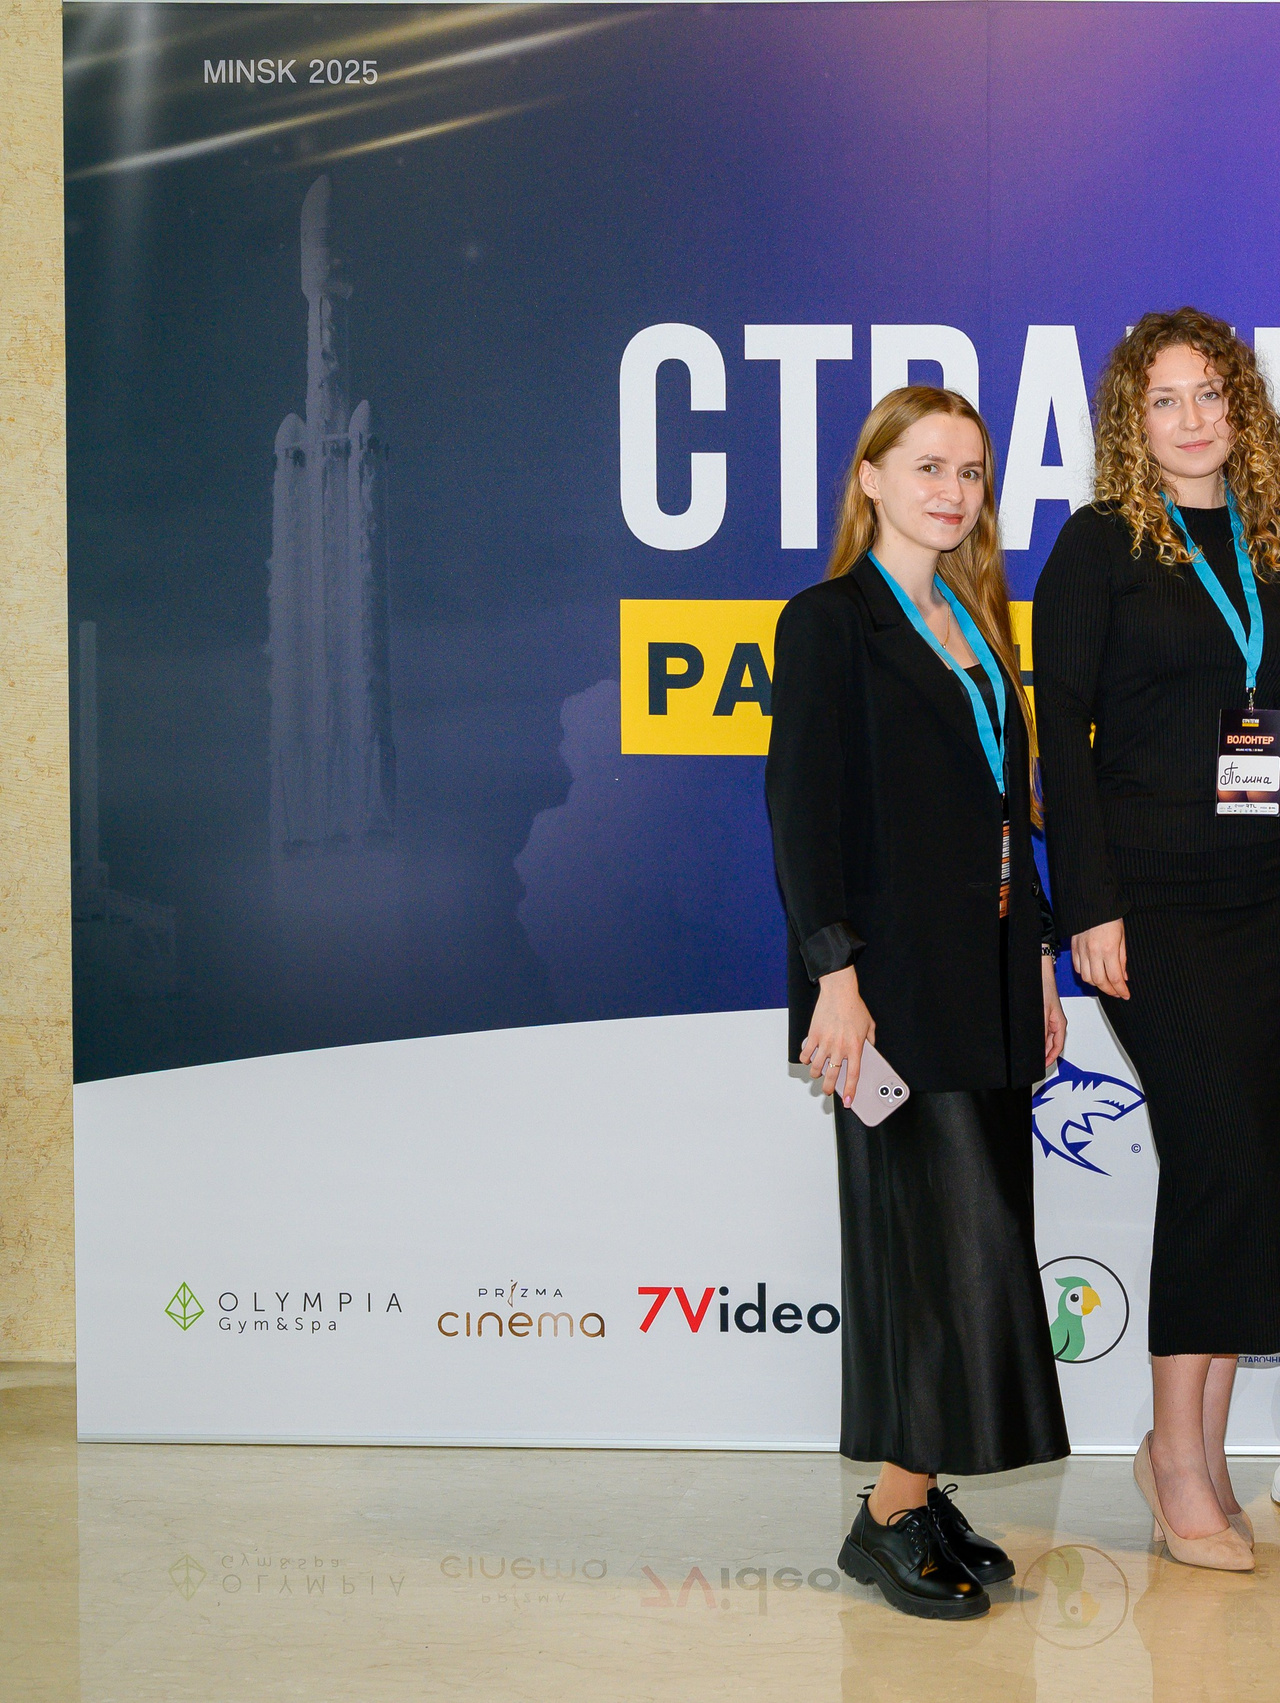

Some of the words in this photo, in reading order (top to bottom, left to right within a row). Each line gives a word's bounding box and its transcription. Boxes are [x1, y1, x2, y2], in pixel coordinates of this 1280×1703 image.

[204, 59, 297, 84] MINSK
[309, 59, 378, 85] 2025
[1227, 735, 1274, 745] ВОЛОНТЕР
[1220, 761, 1272, 785] Полина
[218, 1292, 402, 1312] OLYMPIA
[638, 1282, 841, 1335] 7Video
[218, 1317, 337, 1334] Gym&Spa
[437, 1311, 605, 1338] cinema
